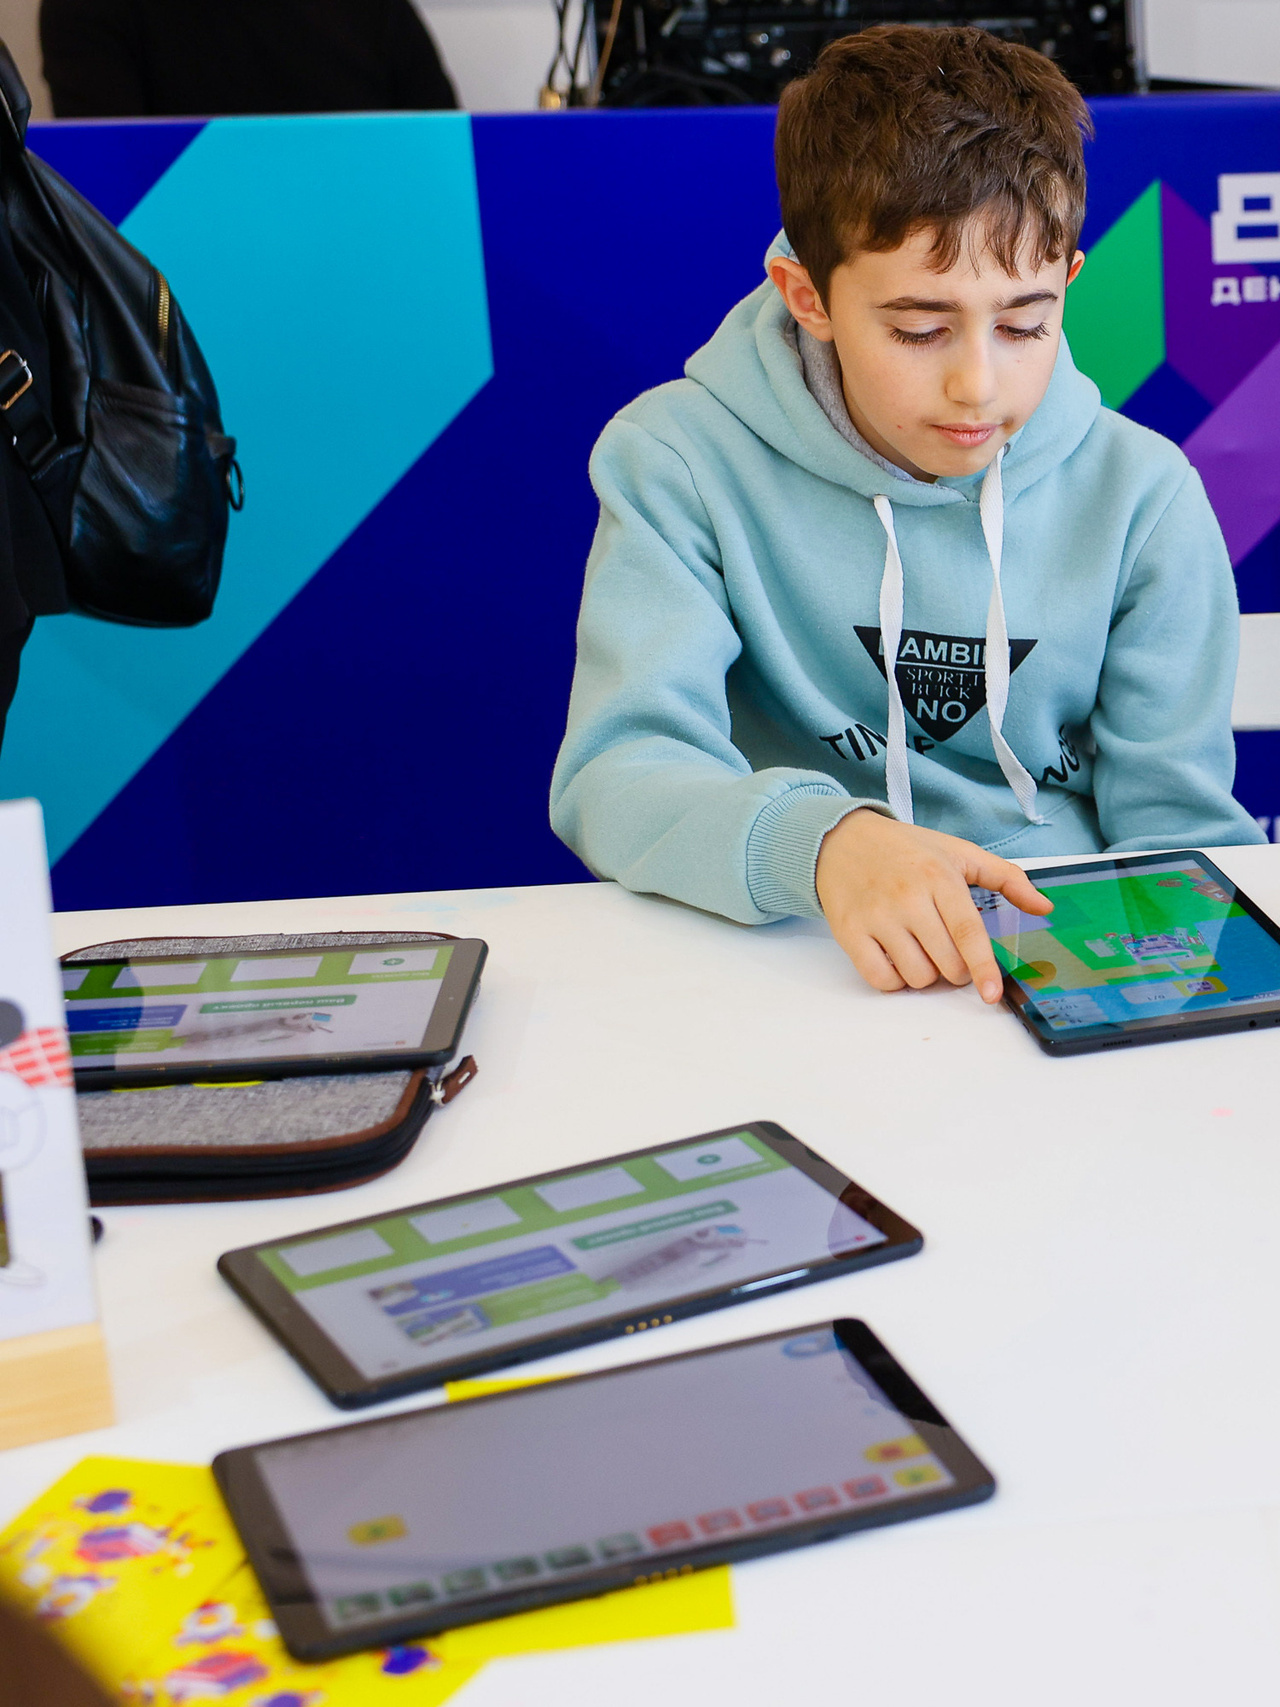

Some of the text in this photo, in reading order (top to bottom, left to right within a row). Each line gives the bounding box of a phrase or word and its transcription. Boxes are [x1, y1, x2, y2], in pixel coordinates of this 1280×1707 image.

[878, 635, 1011, 667] AMBI
[911, 682, 970, 699] BUICK
[916, 698, 967, 723] NO
